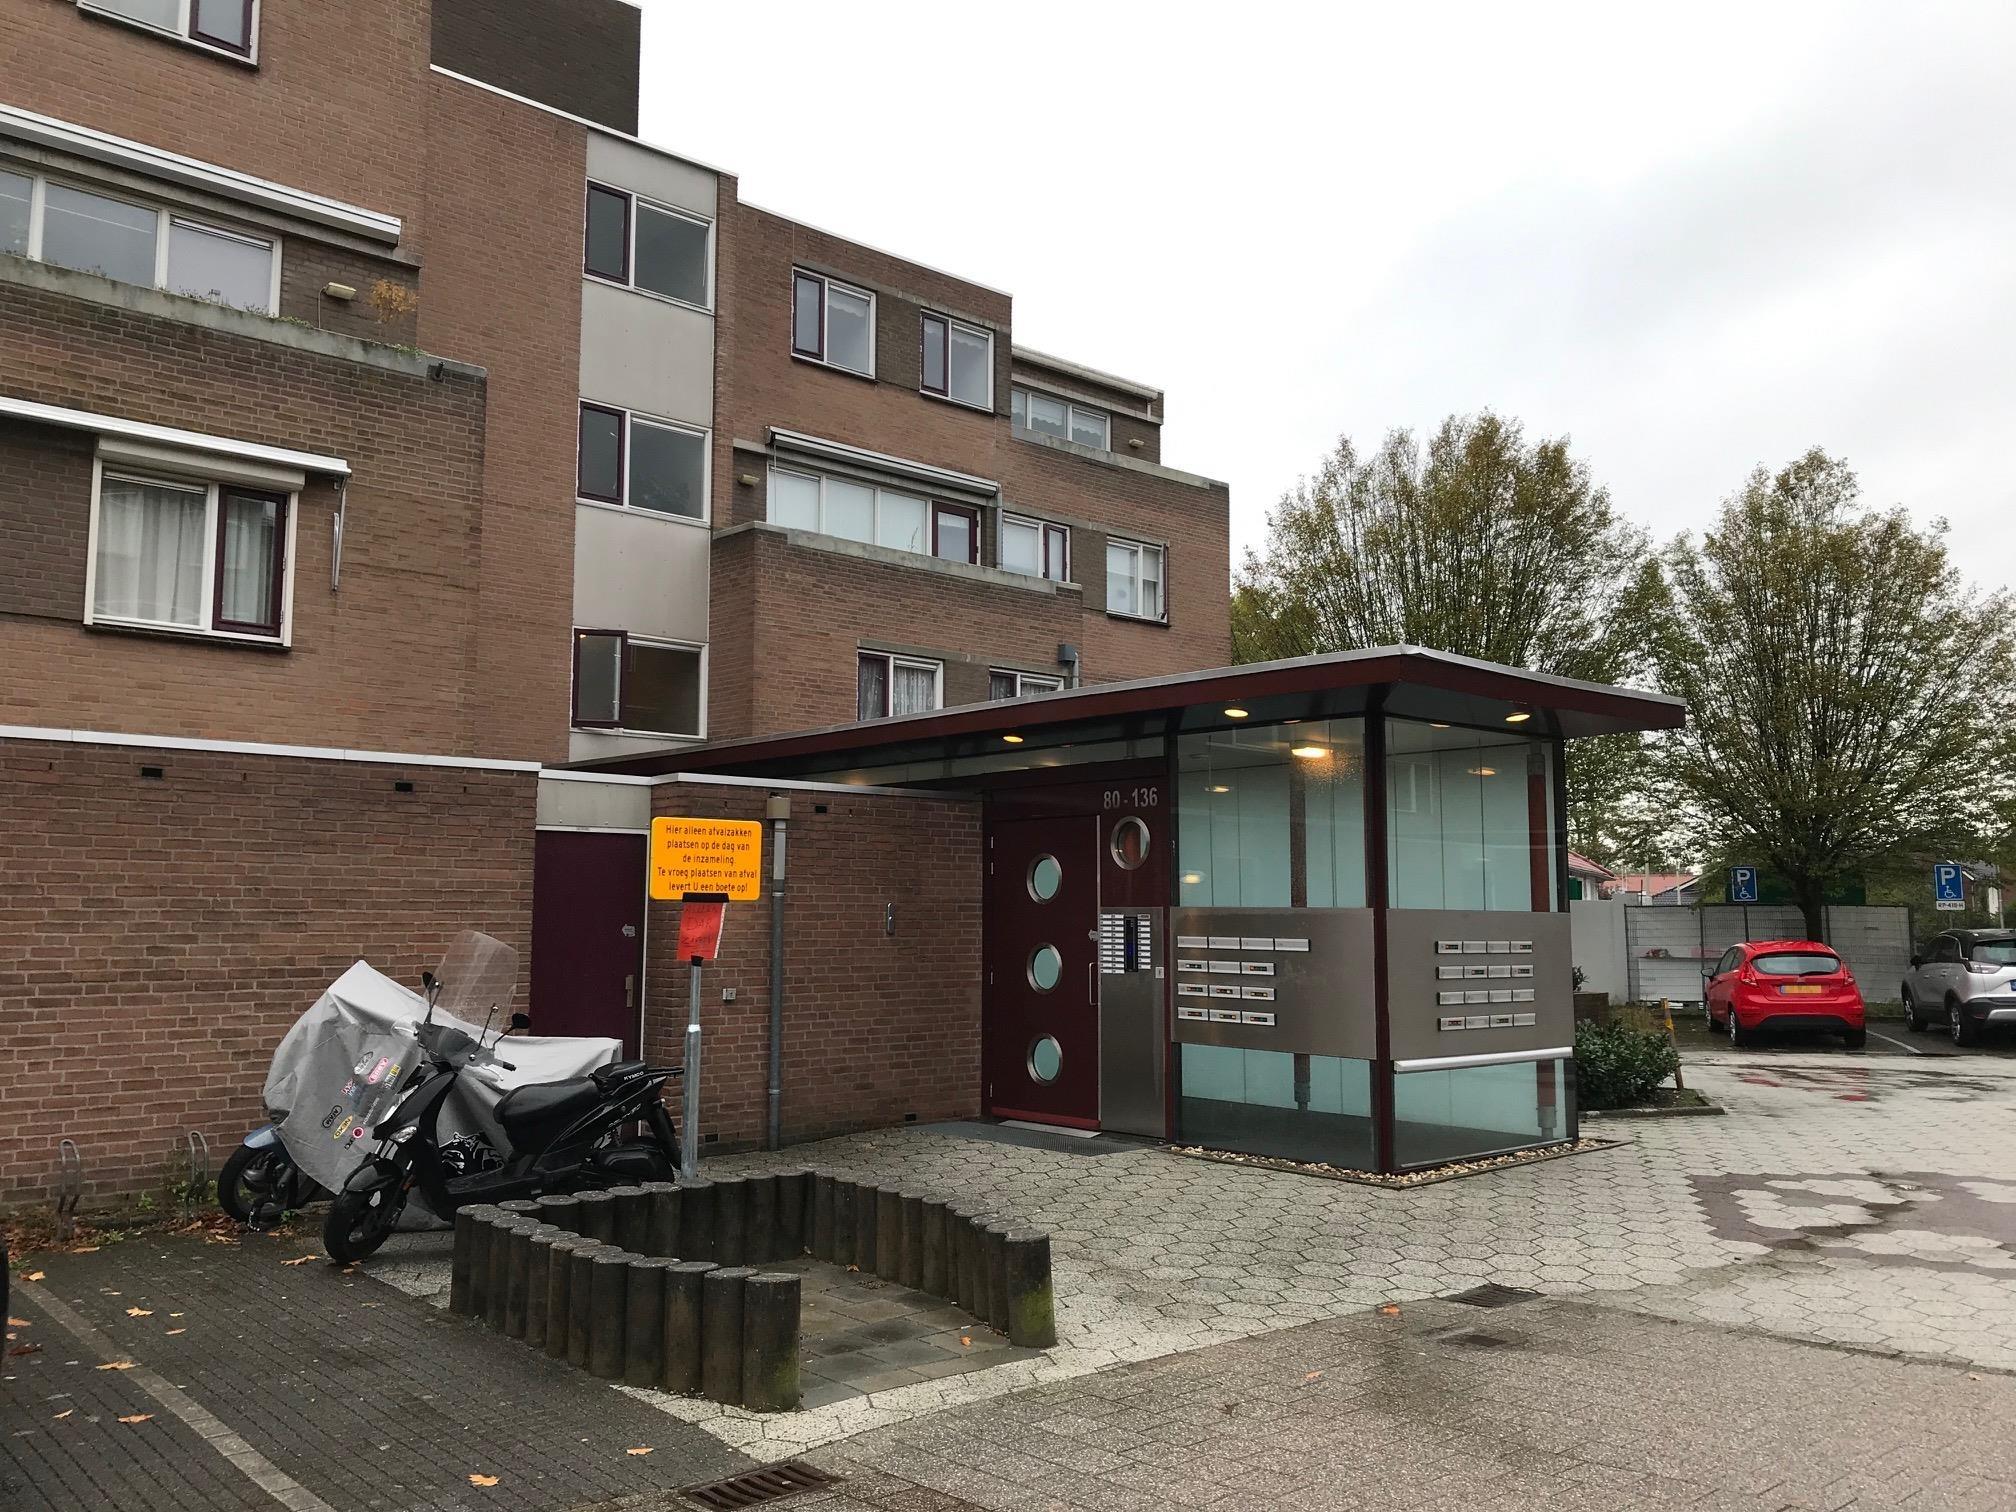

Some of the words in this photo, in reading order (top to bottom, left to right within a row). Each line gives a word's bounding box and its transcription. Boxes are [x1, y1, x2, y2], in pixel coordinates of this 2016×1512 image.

[1104, 790, 1120, 809] 80
[1131, 786, 1158, 808] 136
[665, 825, 682, 835] Hier
[684, 826, 707, 836] alleen
[708, 827, 752, 838] afvalzakken
[667, 840, 699, 850] plaatsen
[701, 842, 710, 851] op
[711, 841, 721, 850] de
[722, 842, 735, 853] dag
[737, 843, 750, 852] van
[682, 853, 692, 863] de
[693, 855, 735, 867] inzameling
[657, 867, 666, 877] Te
[668, 868, 689, 879] vroeg
[690, 868, 722, 879] plaatsen
[724, 871, 738, 879] van
[739, 869, 758, 879] afval
[1737, 870, 1750, 885] P
[1941, 867, 1955, 885] P
[669, 882, 691, 892] levert
[693, 882, 699, 891] U
[700, 884, 713, 892] een
[715, 882, 735, 892] boete
[736, 883, 748, 893] op!
[623, 1071, 644, 1080] KYMCO
